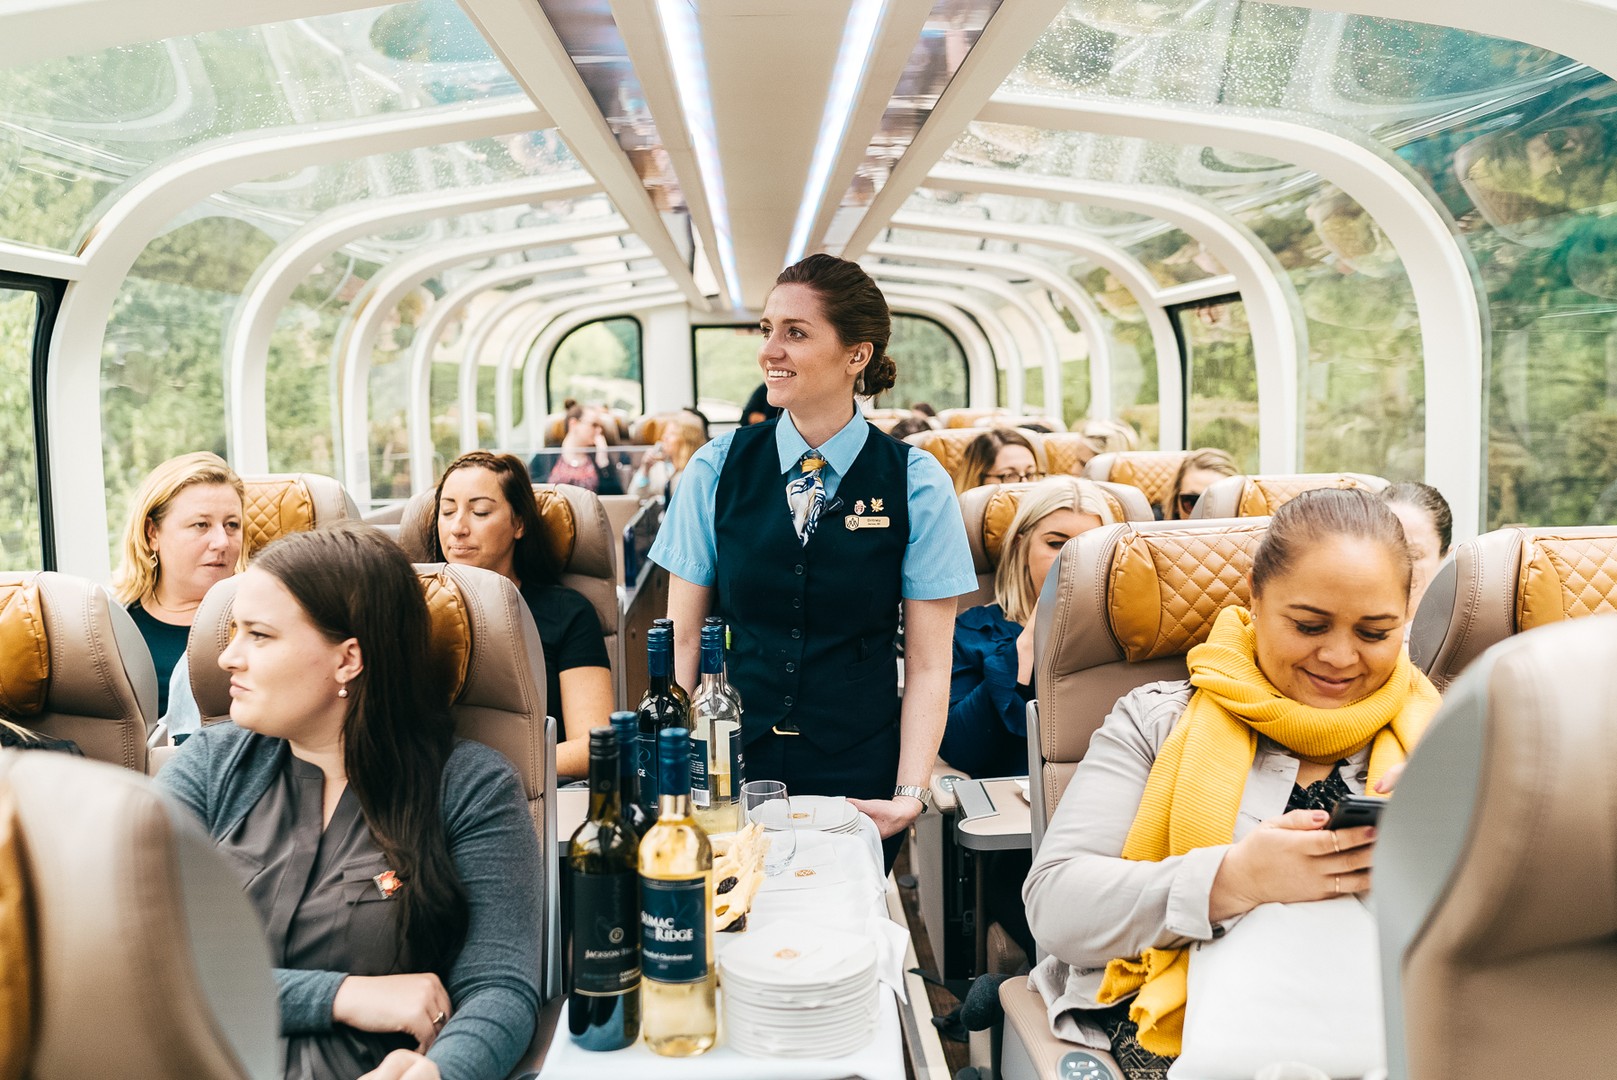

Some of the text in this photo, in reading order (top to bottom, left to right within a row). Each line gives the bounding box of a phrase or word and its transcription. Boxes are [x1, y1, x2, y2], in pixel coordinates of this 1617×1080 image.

[640, 910, 675, 930] SUMAC
[655, 928, 694, 942] RIDGE
[584, 949, 620, 960] JACKSON
